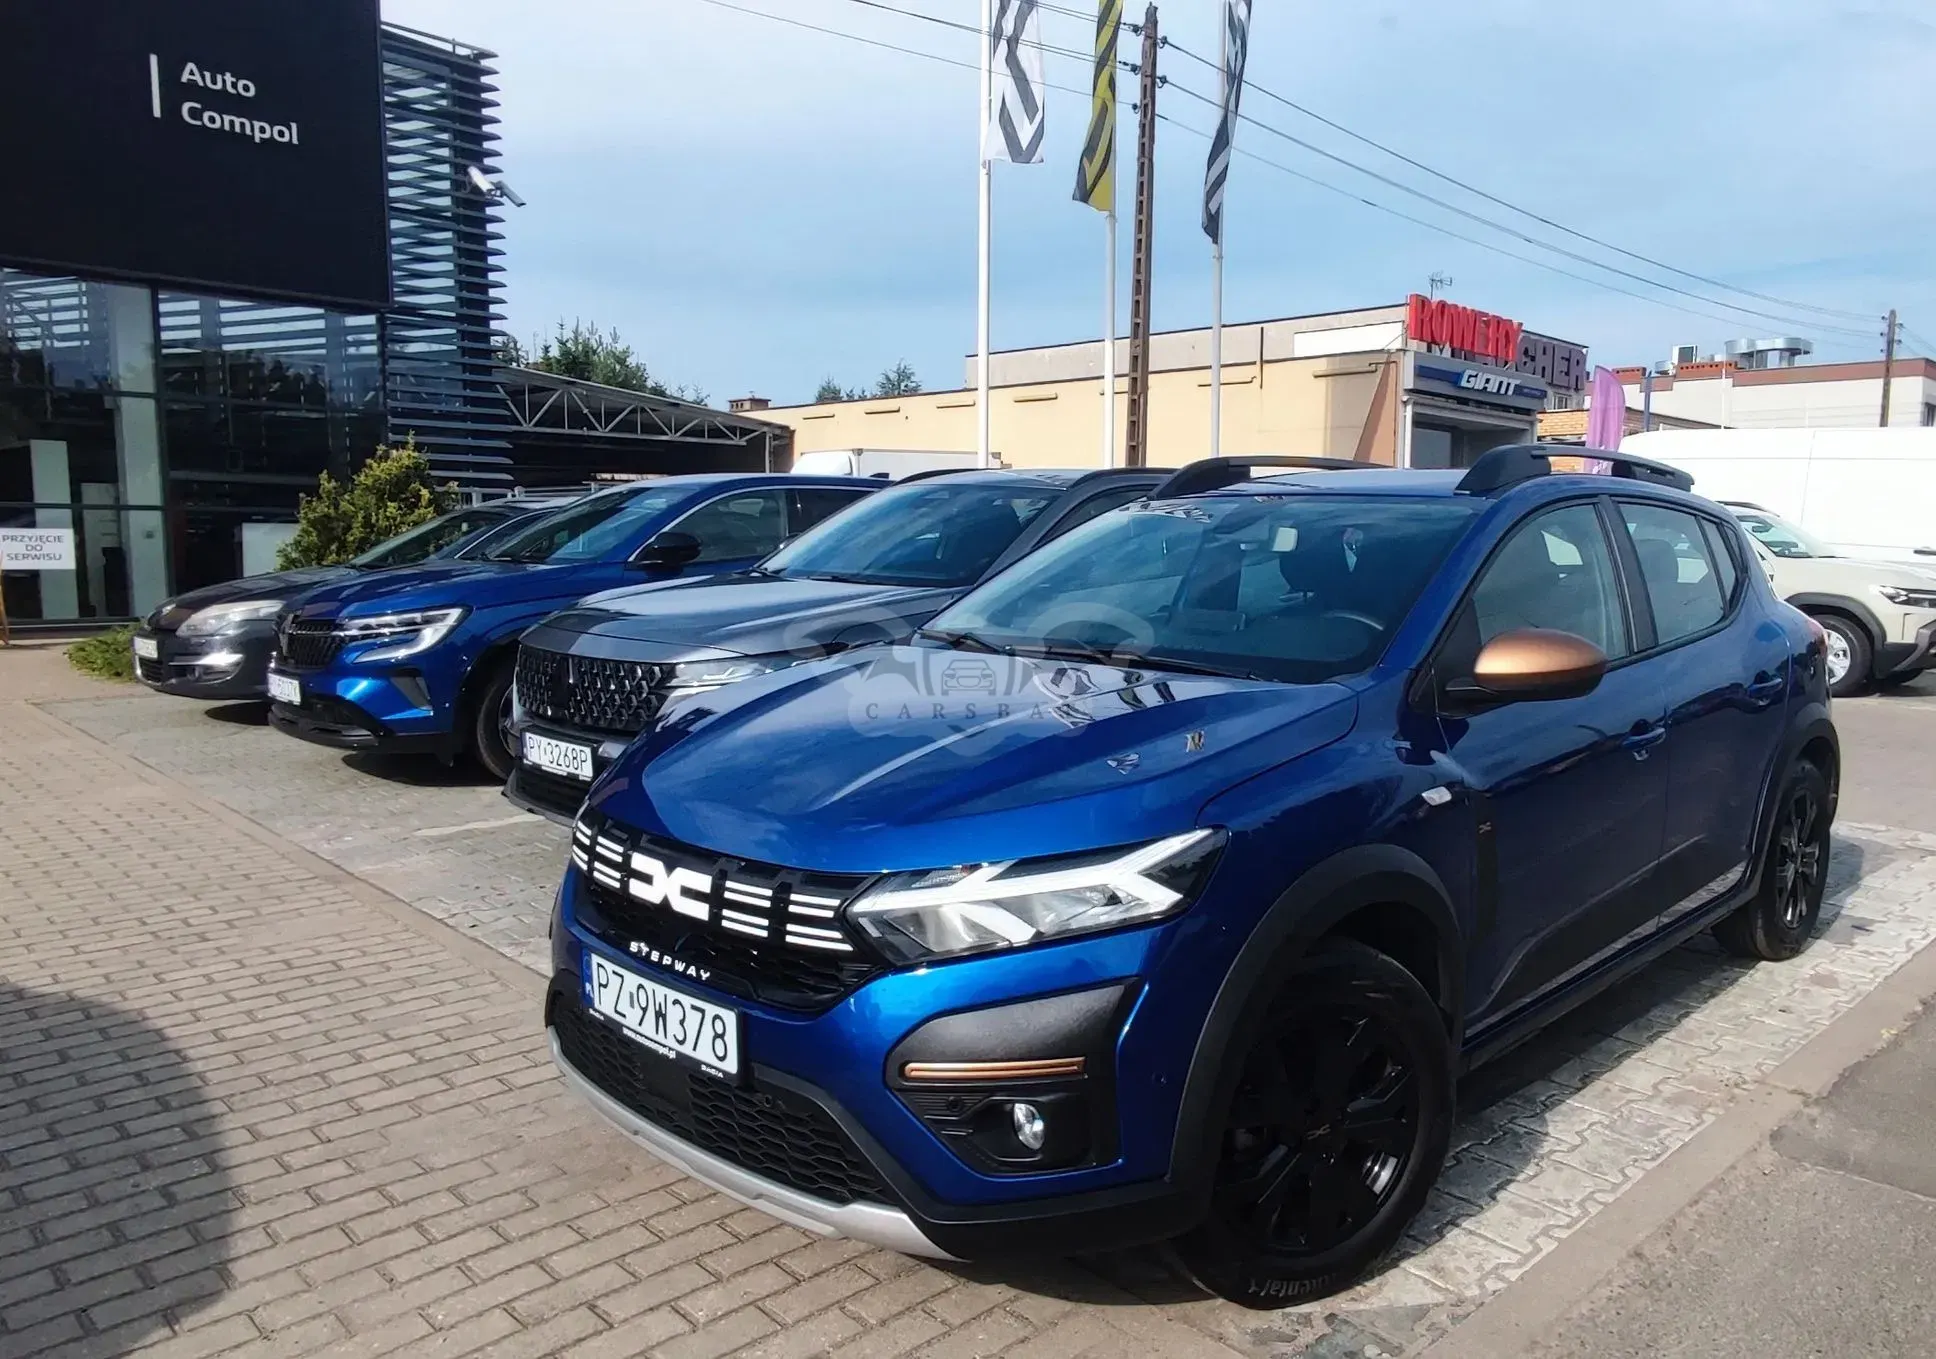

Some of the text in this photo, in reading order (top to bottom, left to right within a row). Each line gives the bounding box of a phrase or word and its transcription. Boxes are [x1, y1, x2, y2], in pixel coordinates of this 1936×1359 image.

[180, 62, 256, 97] Auto
[181, 101, 299, 145] Compol
[1408, 293, 1524, 362] ROWERY
[1460, 368, 1522, 396] GIANT
[2, 534, 65, 544] PRZYJĘCIE
[25, 543, 43, 552] DO
[6, 552, 62, 561] SERWISU
[629, 941, 711, 981] STEPWAY
